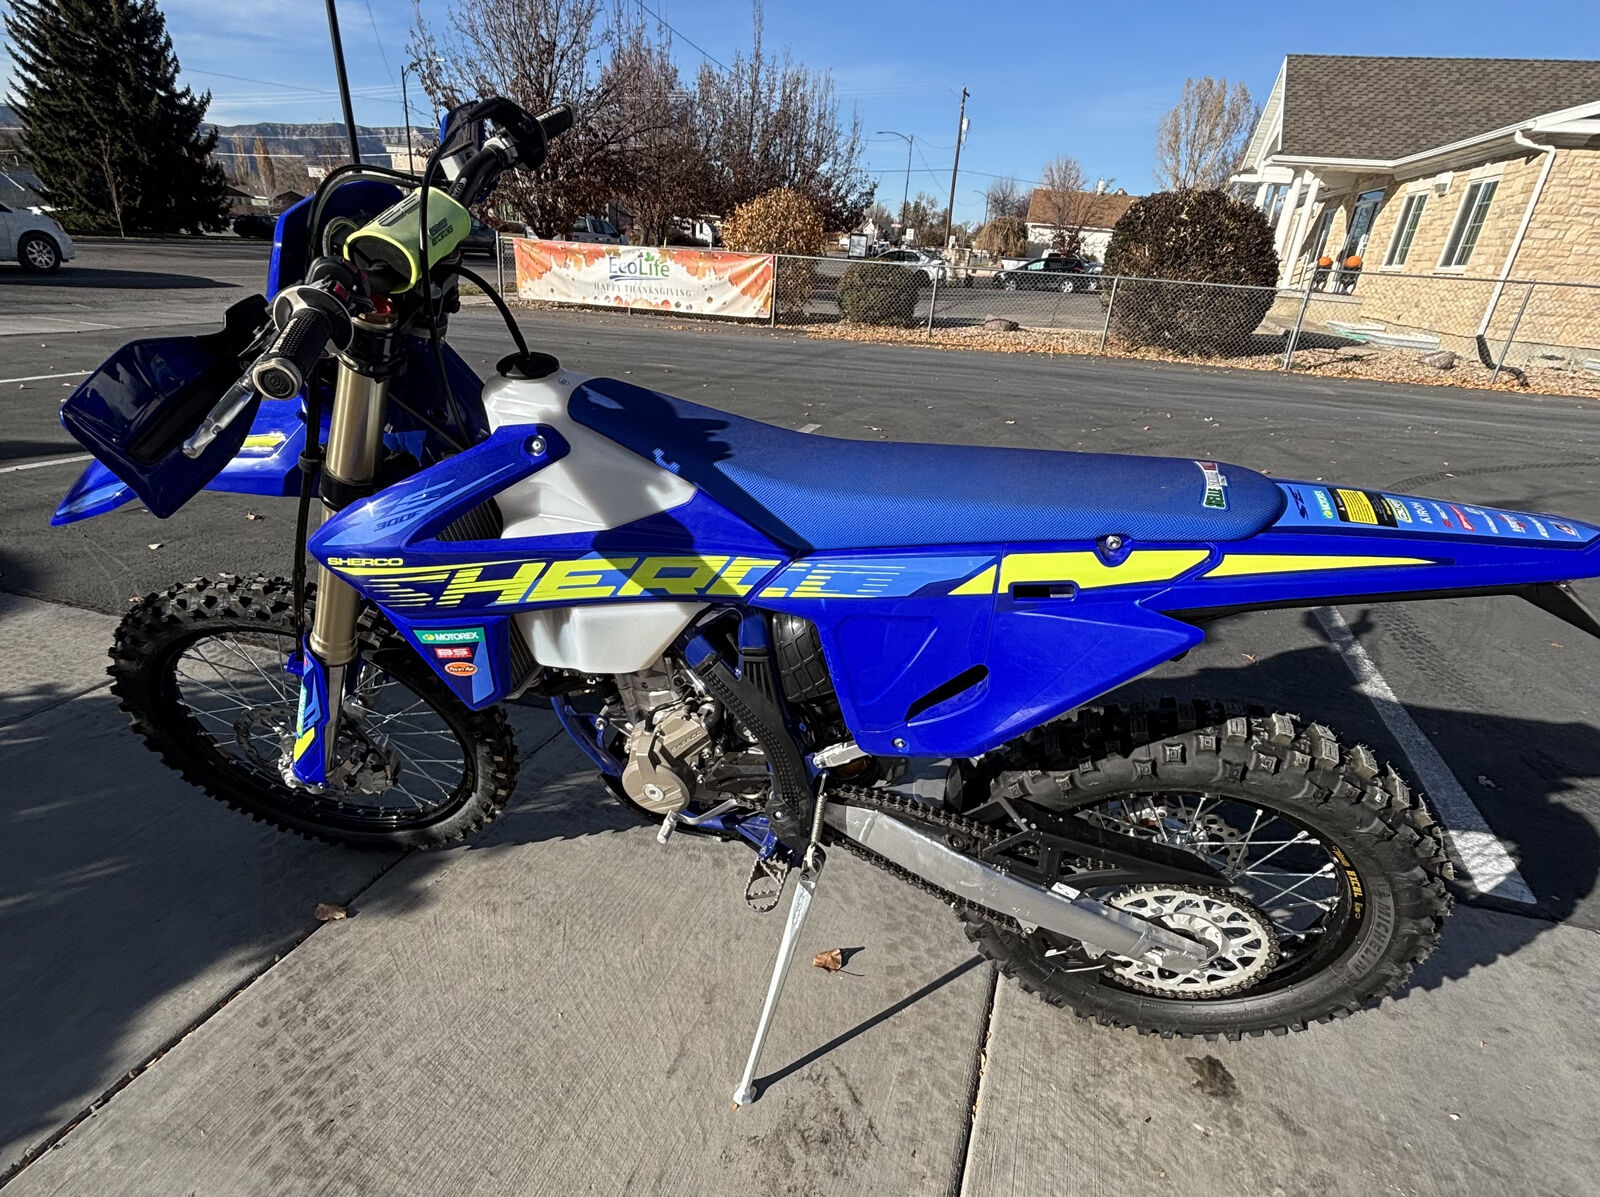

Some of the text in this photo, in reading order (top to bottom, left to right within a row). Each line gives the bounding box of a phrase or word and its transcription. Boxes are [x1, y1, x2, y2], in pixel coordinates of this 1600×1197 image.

[609, 255, 670, 277] EcoLife
[594, 282, 692, 297] HAPPY THANKSGIVING
[327, 557, 404, 567] SHERCO
[434, 632, 479, 641] MOTOREX
[1346, 869, 1363, 898] EXCEL
[1354, 903, 1392, 974] MICHELIN
